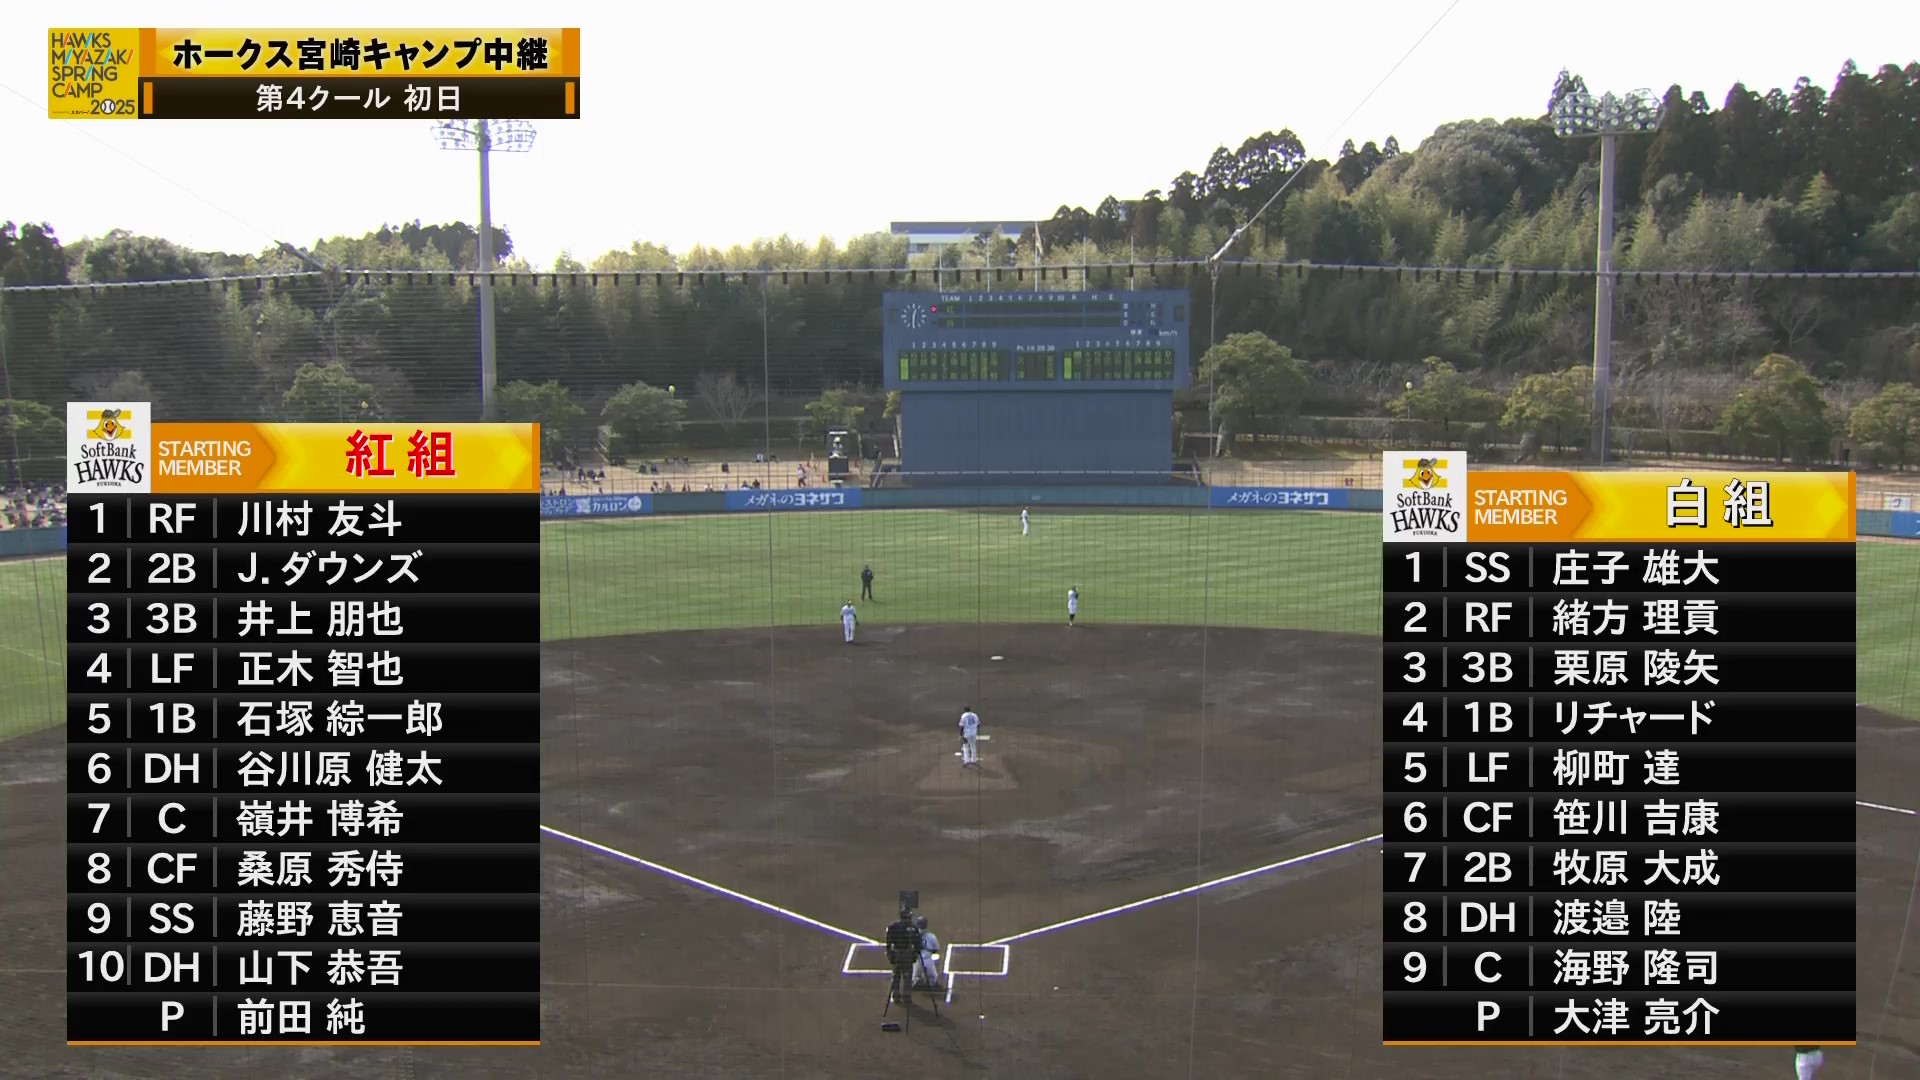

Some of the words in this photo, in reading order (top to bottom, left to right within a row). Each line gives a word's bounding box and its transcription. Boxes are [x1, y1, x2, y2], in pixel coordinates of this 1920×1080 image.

[1227, 490, 1328, 506] メガネのヨネザワ
